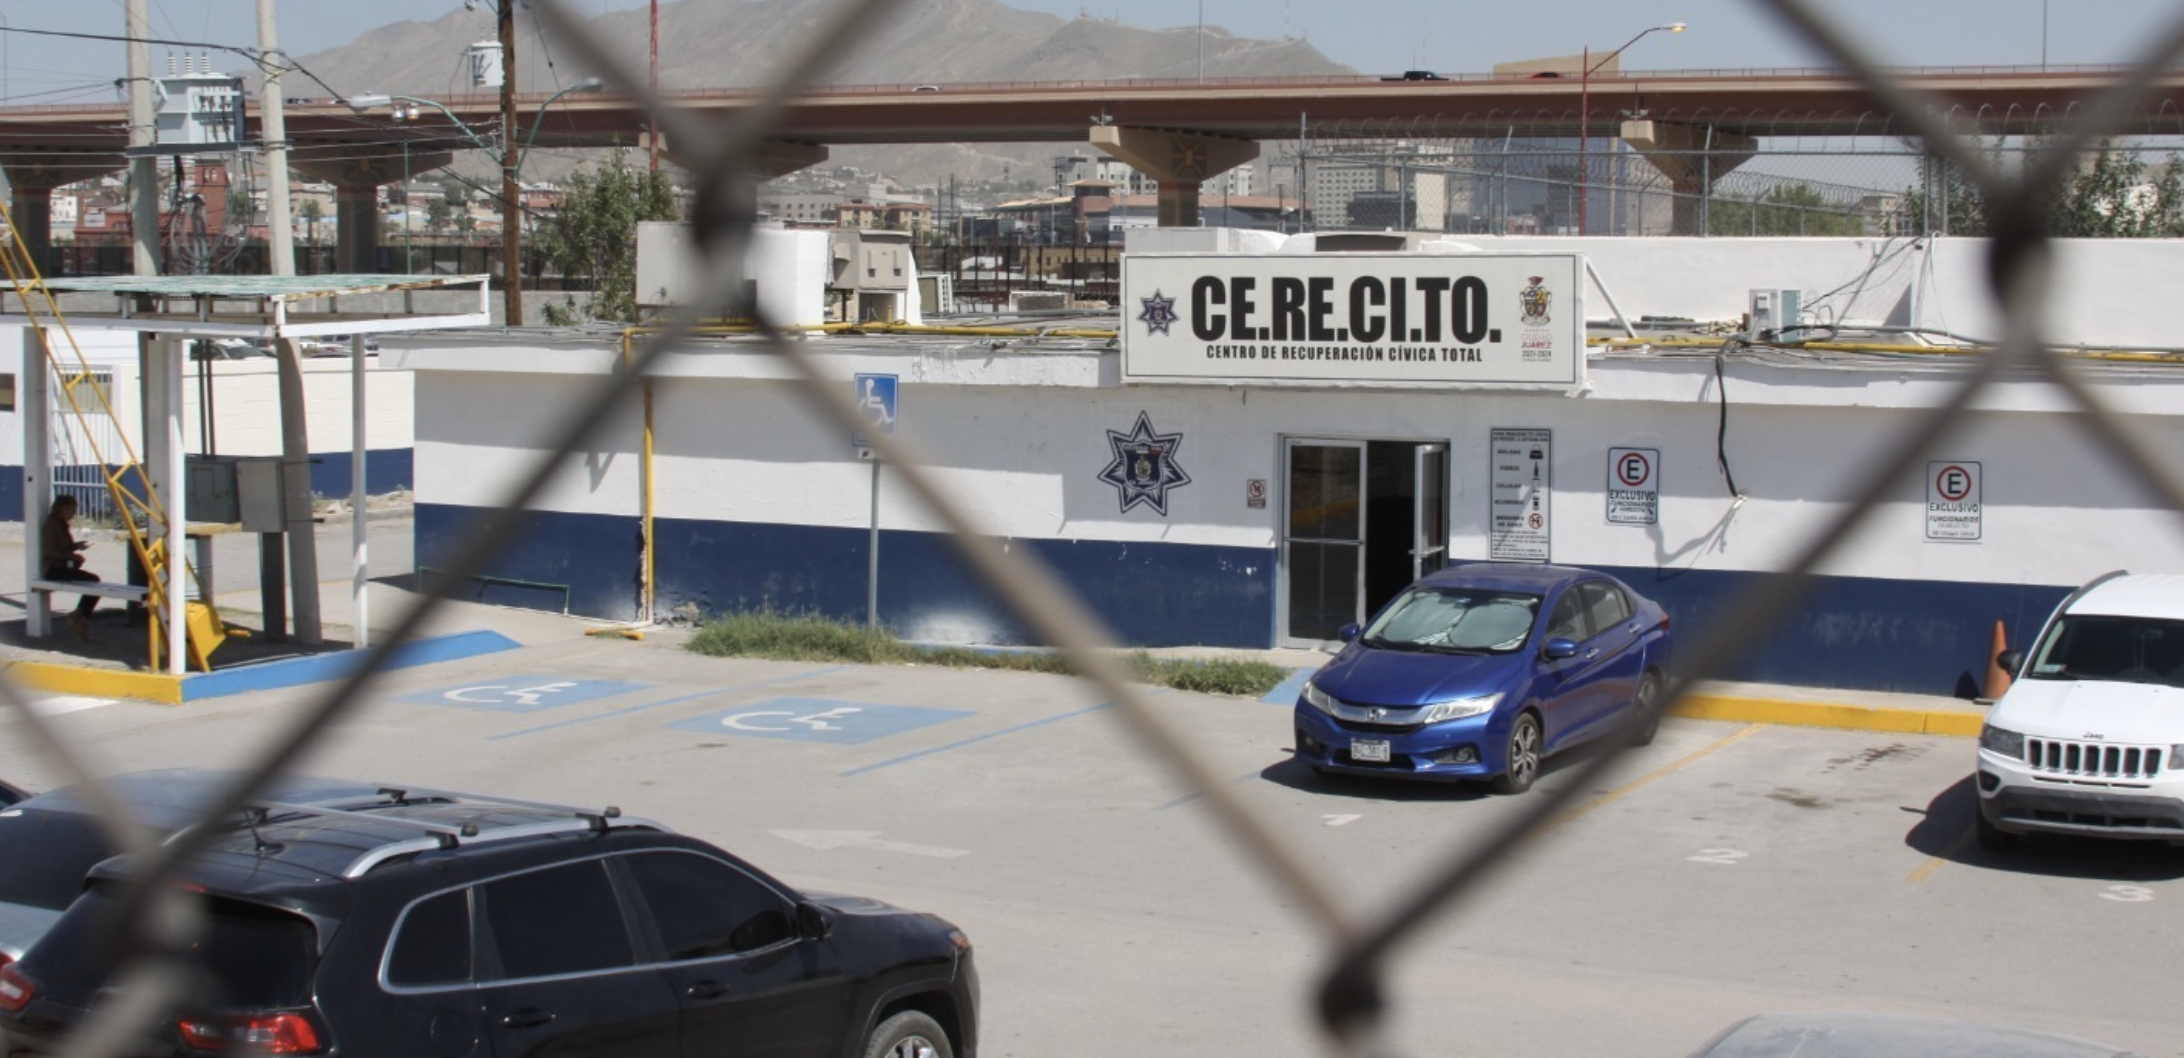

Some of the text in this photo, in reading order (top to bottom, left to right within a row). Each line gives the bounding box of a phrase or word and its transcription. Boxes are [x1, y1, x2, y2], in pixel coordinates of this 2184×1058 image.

[1191, 275, 1502, 344] CE.RE.CI.TO.
[1206, 345, 1483, 362] CENTRO DE RECUPERACIÓN CÍVICA TOTAL
[1627, 459, 1640, 480] E
[1948, 473, 1962, 494] E
[1610, 489, 1655, 501] EXCLUSIVO
[1929, 502, 1979, 513] EXCLUSIVO
[1684, 848, 1750, 865] 2
[2098, 884, 2155, 901] 3
